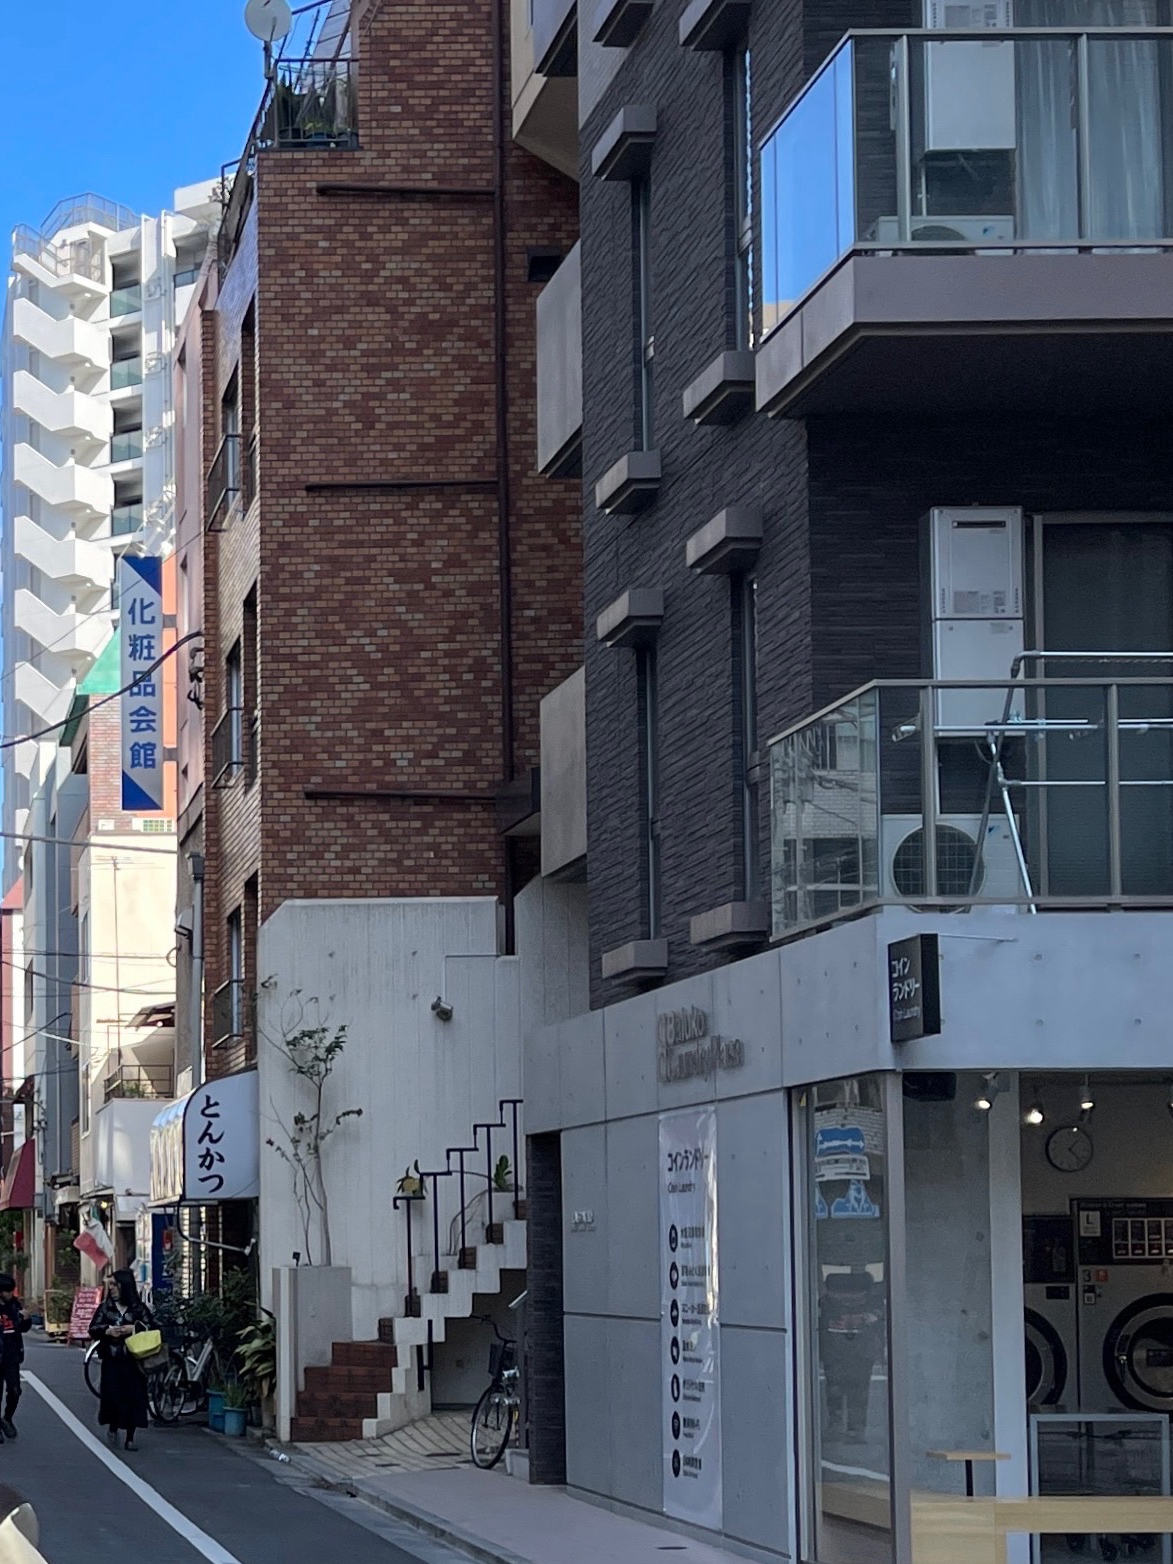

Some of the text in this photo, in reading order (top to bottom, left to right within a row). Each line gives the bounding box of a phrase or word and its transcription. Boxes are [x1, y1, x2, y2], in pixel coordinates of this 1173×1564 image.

[128, 597, 157, 769] 化粧品会館
[891, 957, 911, 978] コイン
[892, 978, 921, 1002] ランドリー
[197, 1094, 225, 1194] とんかつ
[667, 1147, 710, 1172] コインランドリー
